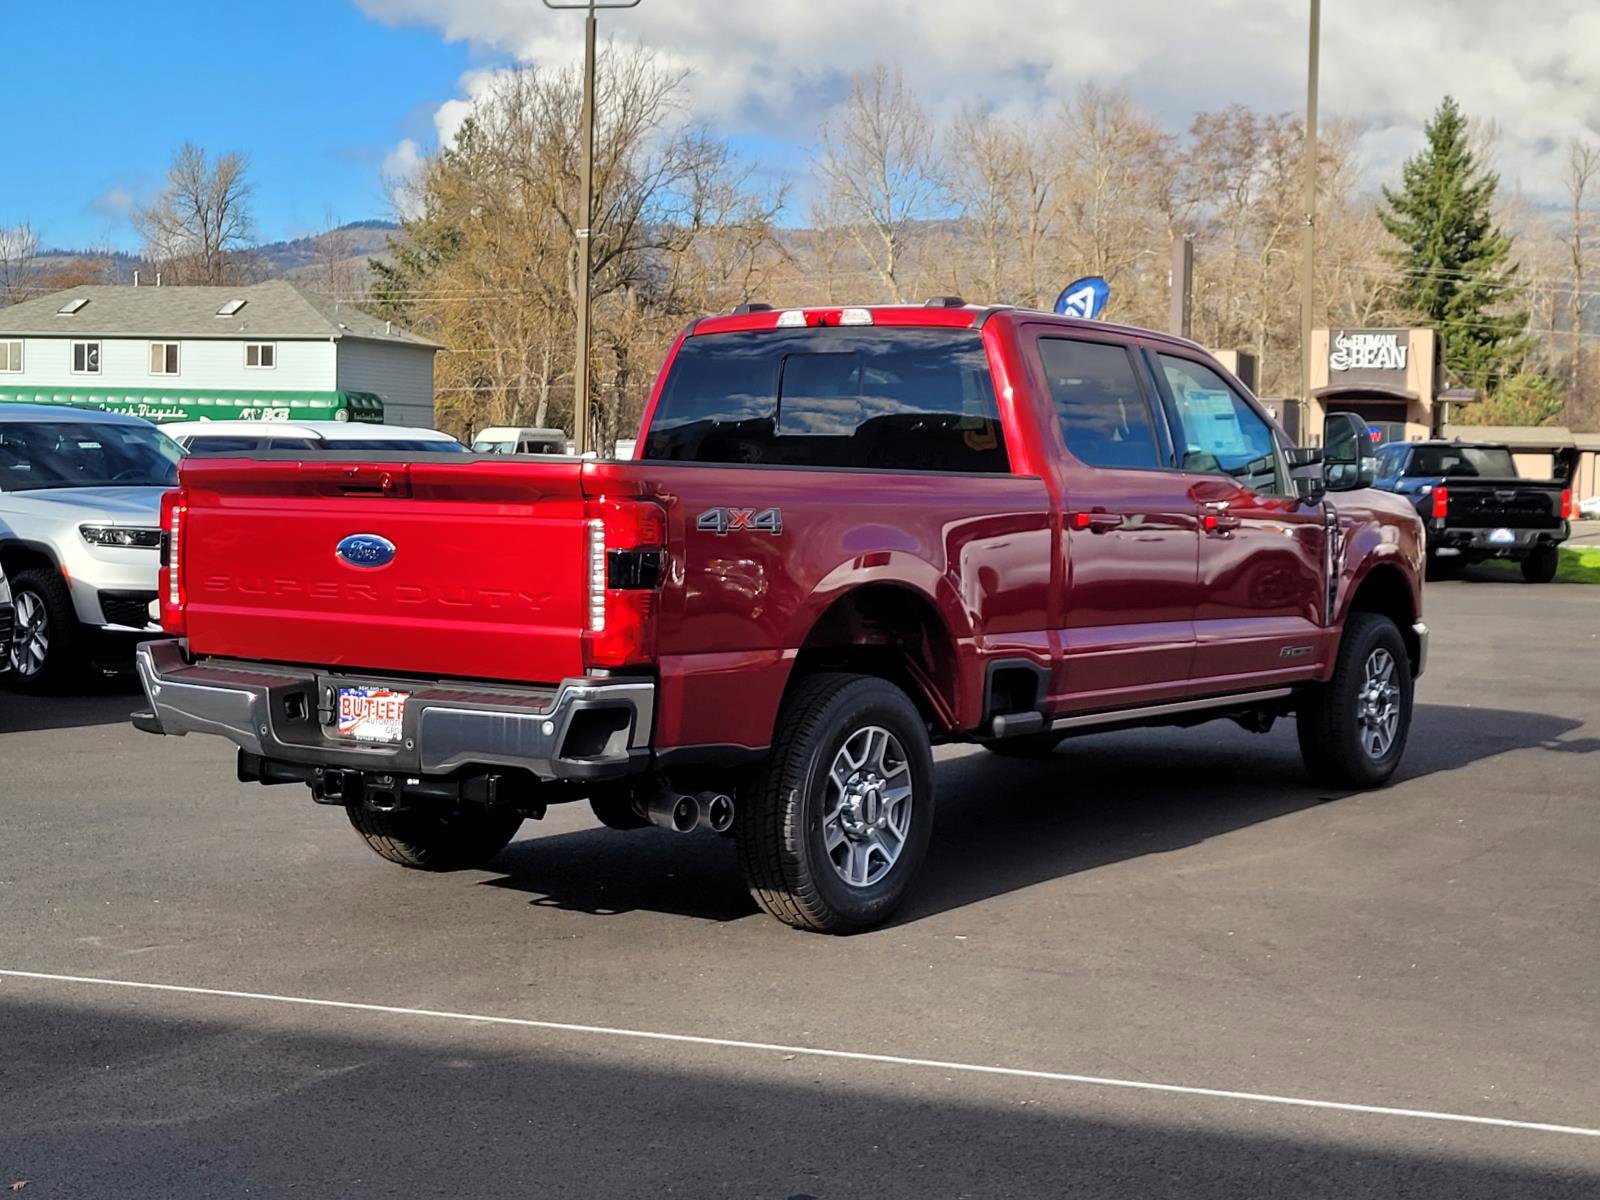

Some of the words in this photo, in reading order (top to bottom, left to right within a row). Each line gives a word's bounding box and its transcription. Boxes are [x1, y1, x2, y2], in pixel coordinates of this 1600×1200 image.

[1350, 345, 1408, 369] BEAN
[138, 404, 188, 421] Bicycle
[203, 575, 377, 601] SUPER
[394, 583, 553, 612] DUTY
